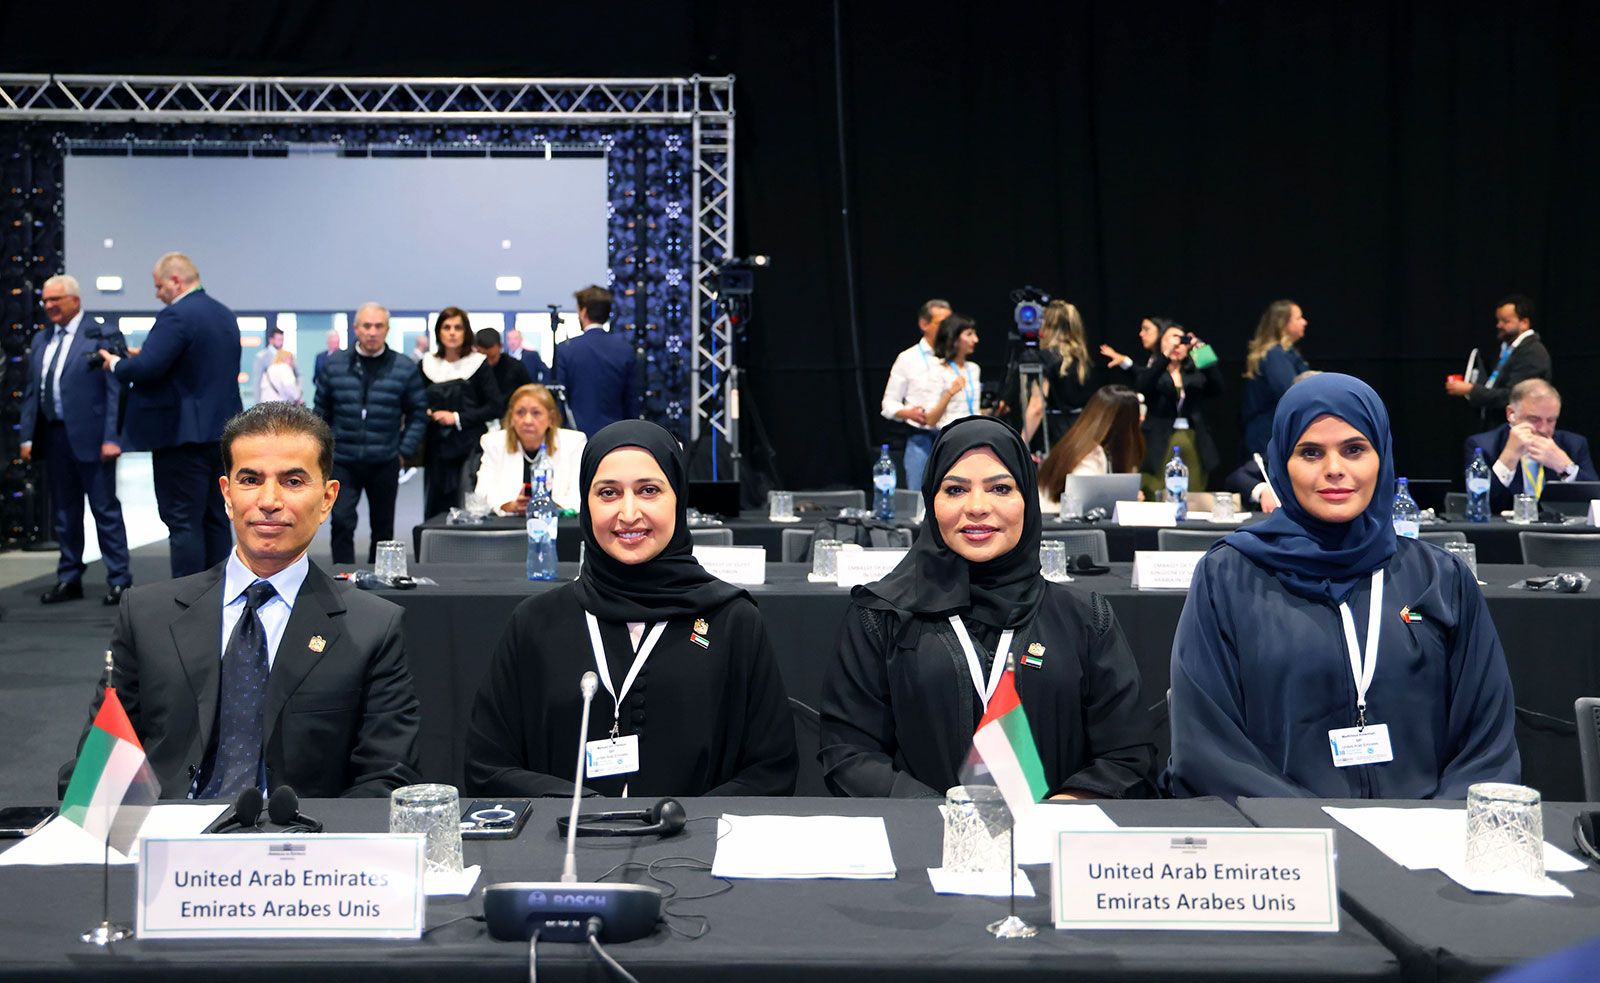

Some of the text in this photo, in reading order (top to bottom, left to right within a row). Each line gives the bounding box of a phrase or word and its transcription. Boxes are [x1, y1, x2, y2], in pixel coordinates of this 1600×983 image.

[174, 868, 389, 888] United Arab Emirates
[1088, 862, 1301, 881] United Arab Emirates
[180, 899, 381, 918] Emirats Arabes Unis
[553, 894, 607, 907] BOSCH
[1096, 892, 1296, 911] Emirats Arabes Unis
